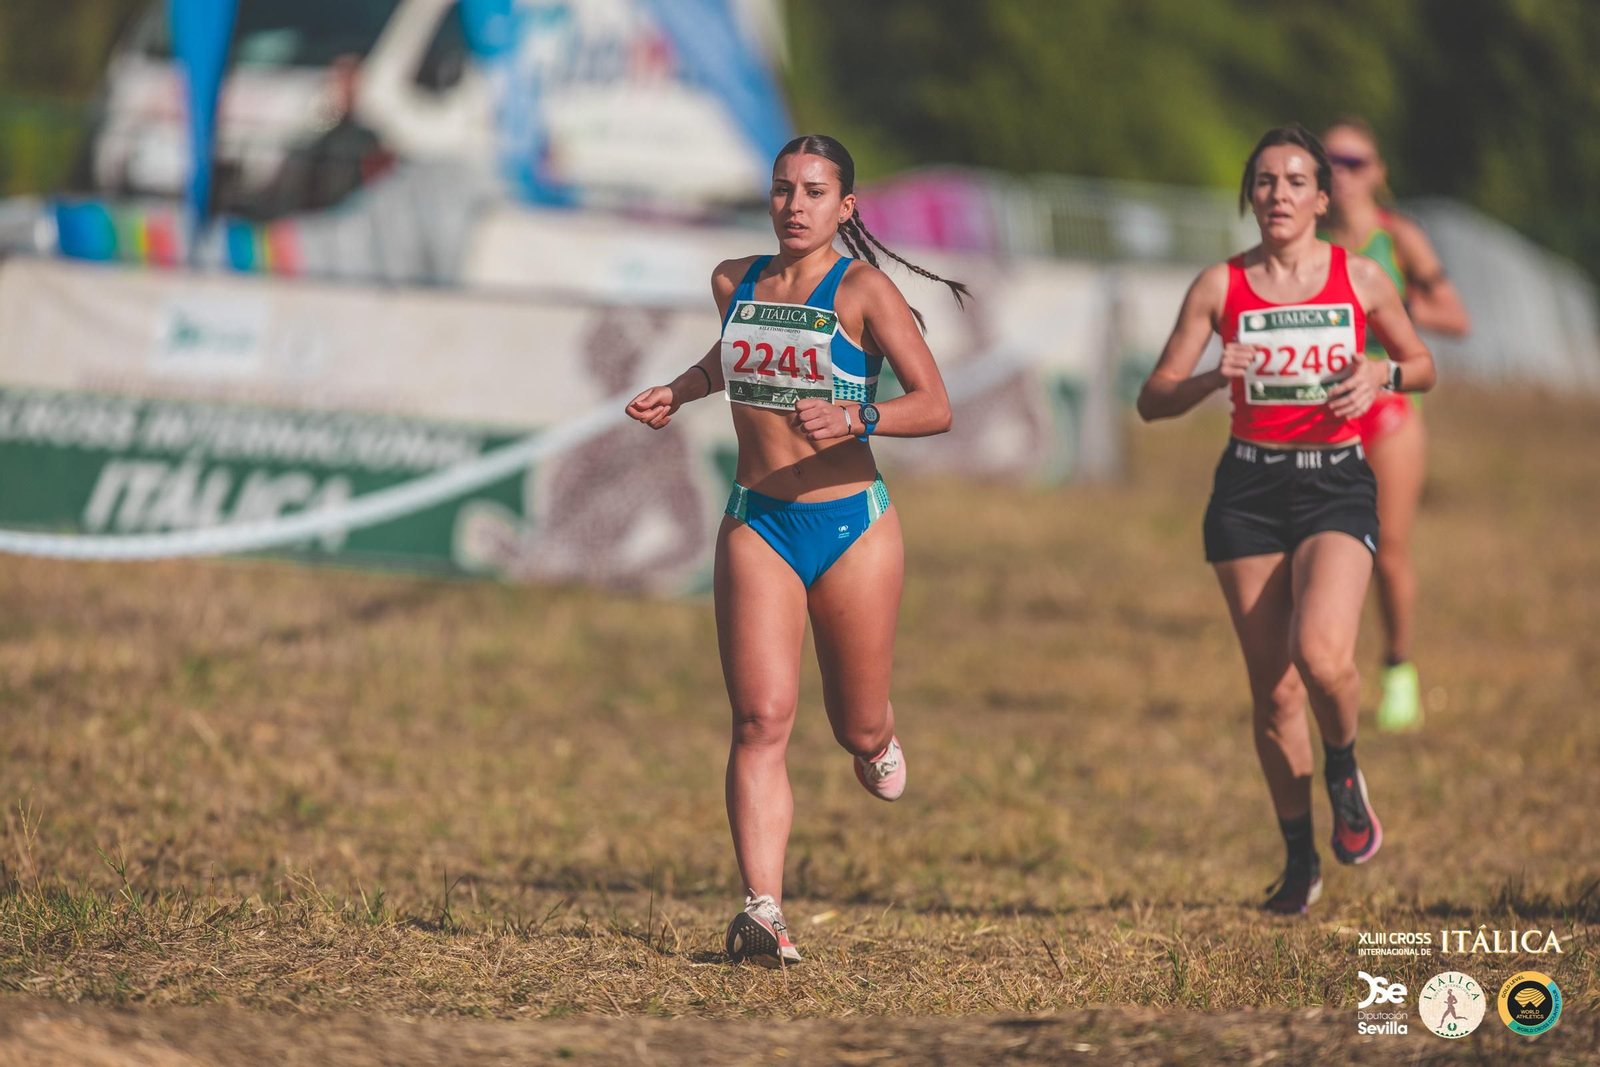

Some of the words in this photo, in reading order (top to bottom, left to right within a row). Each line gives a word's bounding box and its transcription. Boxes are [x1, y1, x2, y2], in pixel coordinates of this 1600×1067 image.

[760, 307, 807, 323] ITÁLICA
[732, 340, 825, 381] 2241
[1255, 344, 1348, 377] 2246
[1235, 443, 1257, 464] NIKE
[1295, 450, 1323, 469] NIKE
